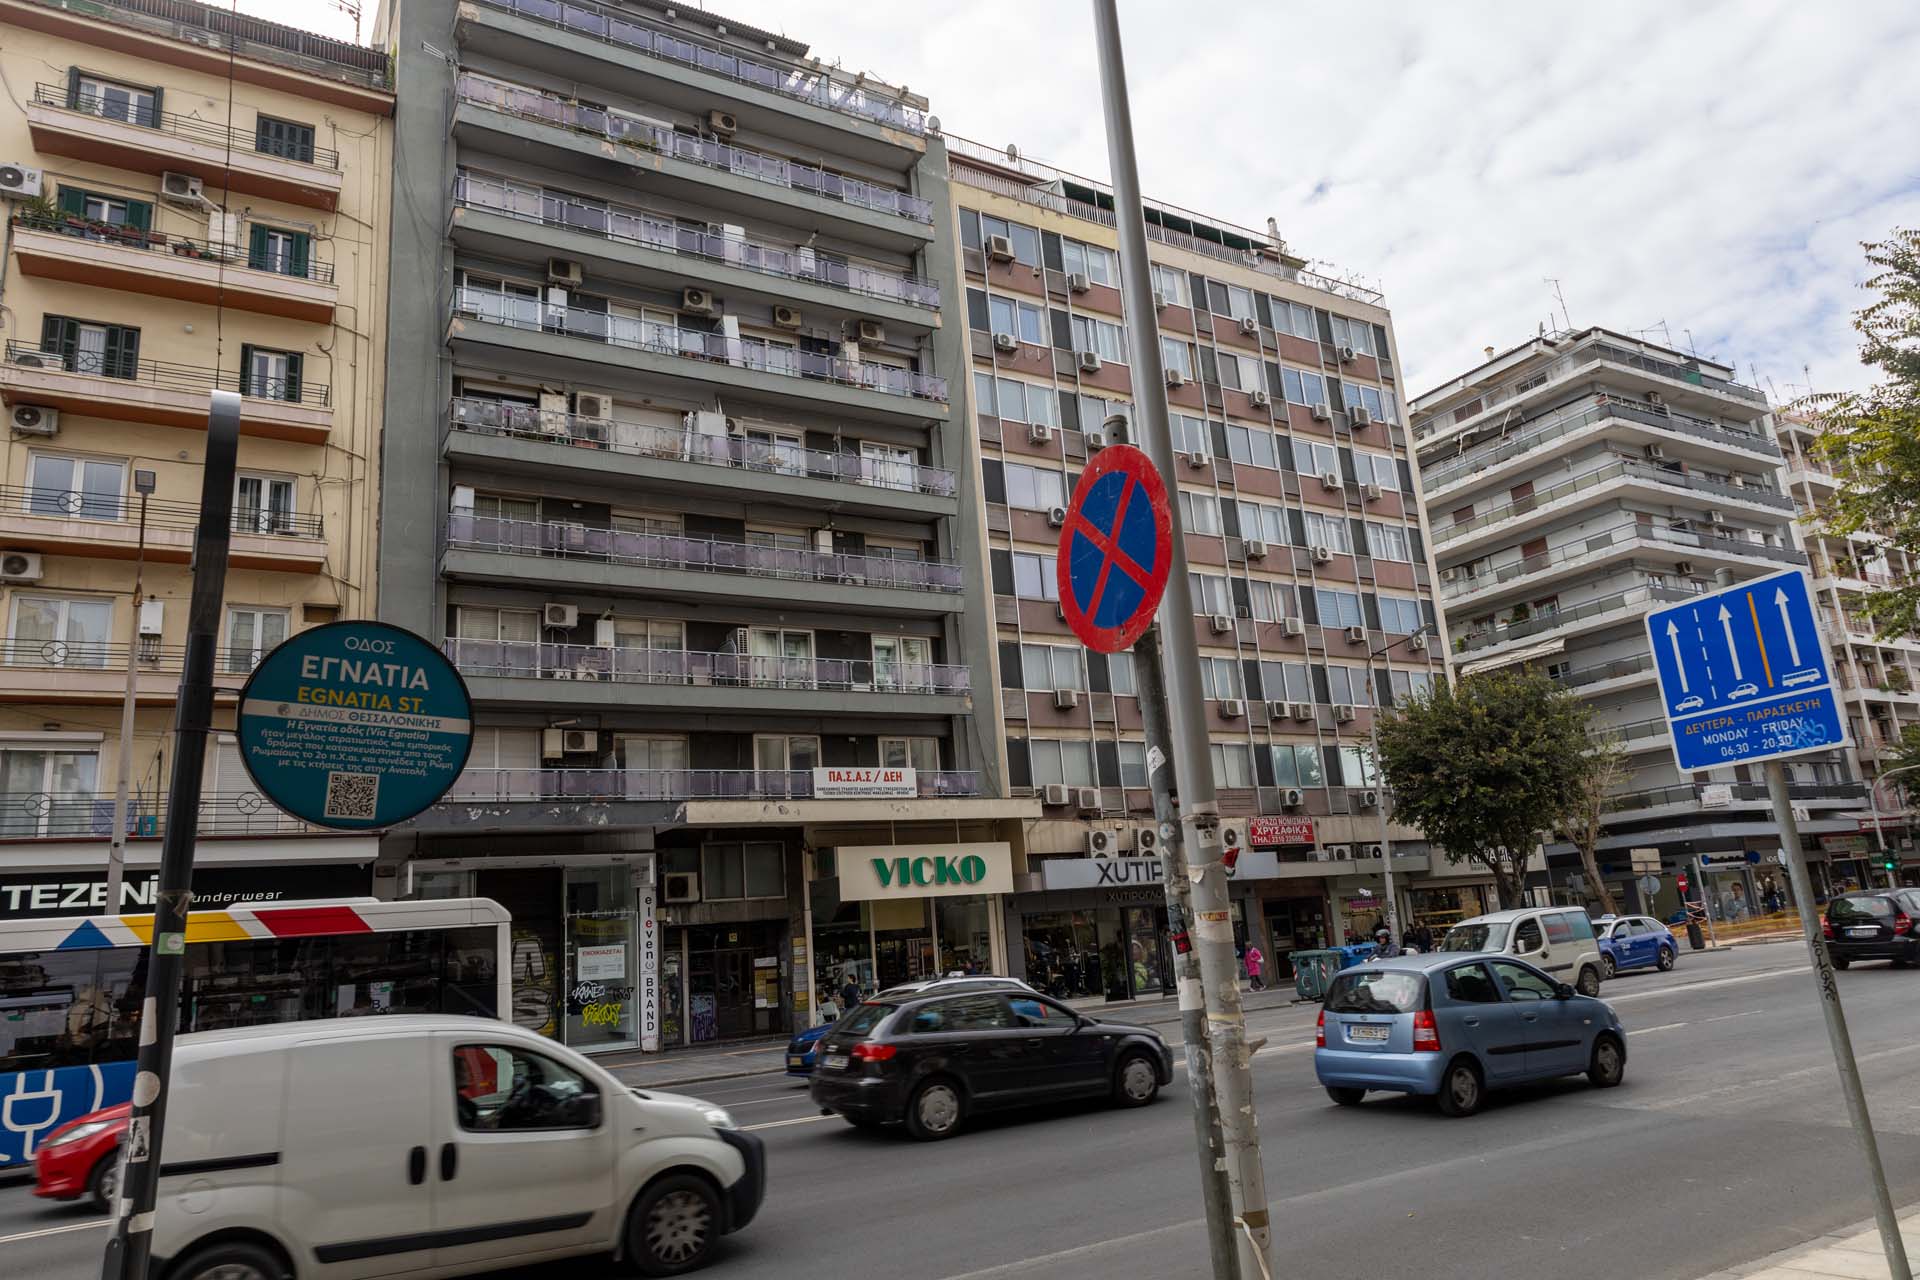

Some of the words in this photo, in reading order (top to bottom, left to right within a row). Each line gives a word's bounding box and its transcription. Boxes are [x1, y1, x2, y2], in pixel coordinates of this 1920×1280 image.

[344, 636, 395, 654] ΟΔΟΣ
[301, 654, 430, 690] ΕΓΝΑΤΙΑ
[297, 686, 392, 710] EGNATIA
[398, 696, 426, 714] ST.
[298, 720, 338, 732] Εγνατία
[340, 724, 364, 736] οδός
[299, 708, 346, 720] ΔΗΜΟΣ
[349, 712, 441, 728] ΘΕΣΣΑΛΟΝΙΚΗΣ
[1685, 716, 1735, 735] ΔΕΥΤΕΡΑ
[1747, 698, 1822, 722] ΠΑΡΑΣΚΕΥΗ
[1702, 728, 1749, 745] MONDAY
[1762, 717, 1804, 734] FRIDAY
[1720, 742, 1750, 757] 06:30
[1762, 734, 1792, 750] 20:30
[828, 770, 872, 782] ΠΑ.Σ.Α.Σ
[884, 770, 902, 782] ΔΕΗ
[1256, 825, 1308, 835] ΧΡΥΣΑΦΙΚΑ
[872, 855, 986, 888] VICKO
[1096, 861, 1163, 884] XUTIP
[1, 874, 159, 911] TEZENI
[192, 890, 283, 903] underwear
[645, 896, 654, 960] eleven
[646, 978, 656, 1031] BRAND
